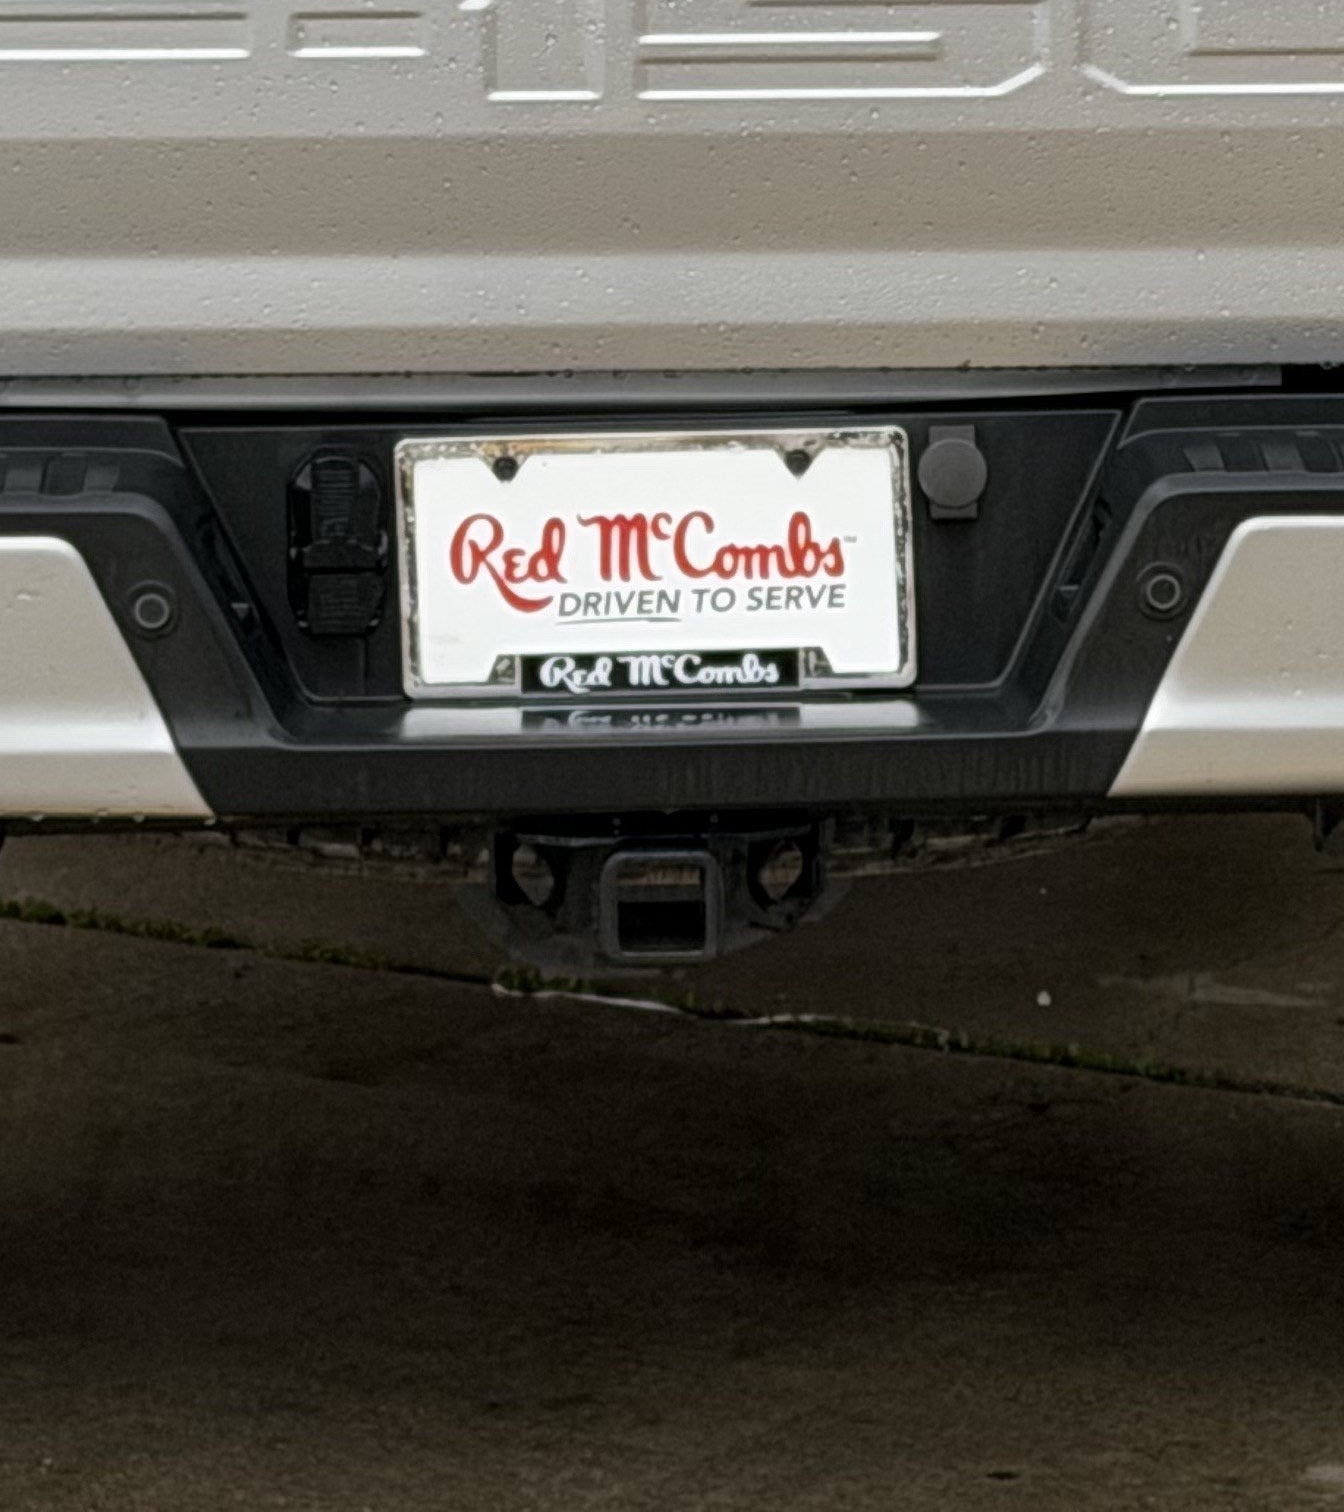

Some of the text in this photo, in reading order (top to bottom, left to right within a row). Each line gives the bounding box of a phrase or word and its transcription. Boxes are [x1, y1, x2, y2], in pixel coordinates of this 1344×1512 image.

[449, 509, 847, 613] Red McCombs
[558, 584, 847, 618] DRIVEN TO SERVE
[539, 652, 780, 694] Red McCombs
